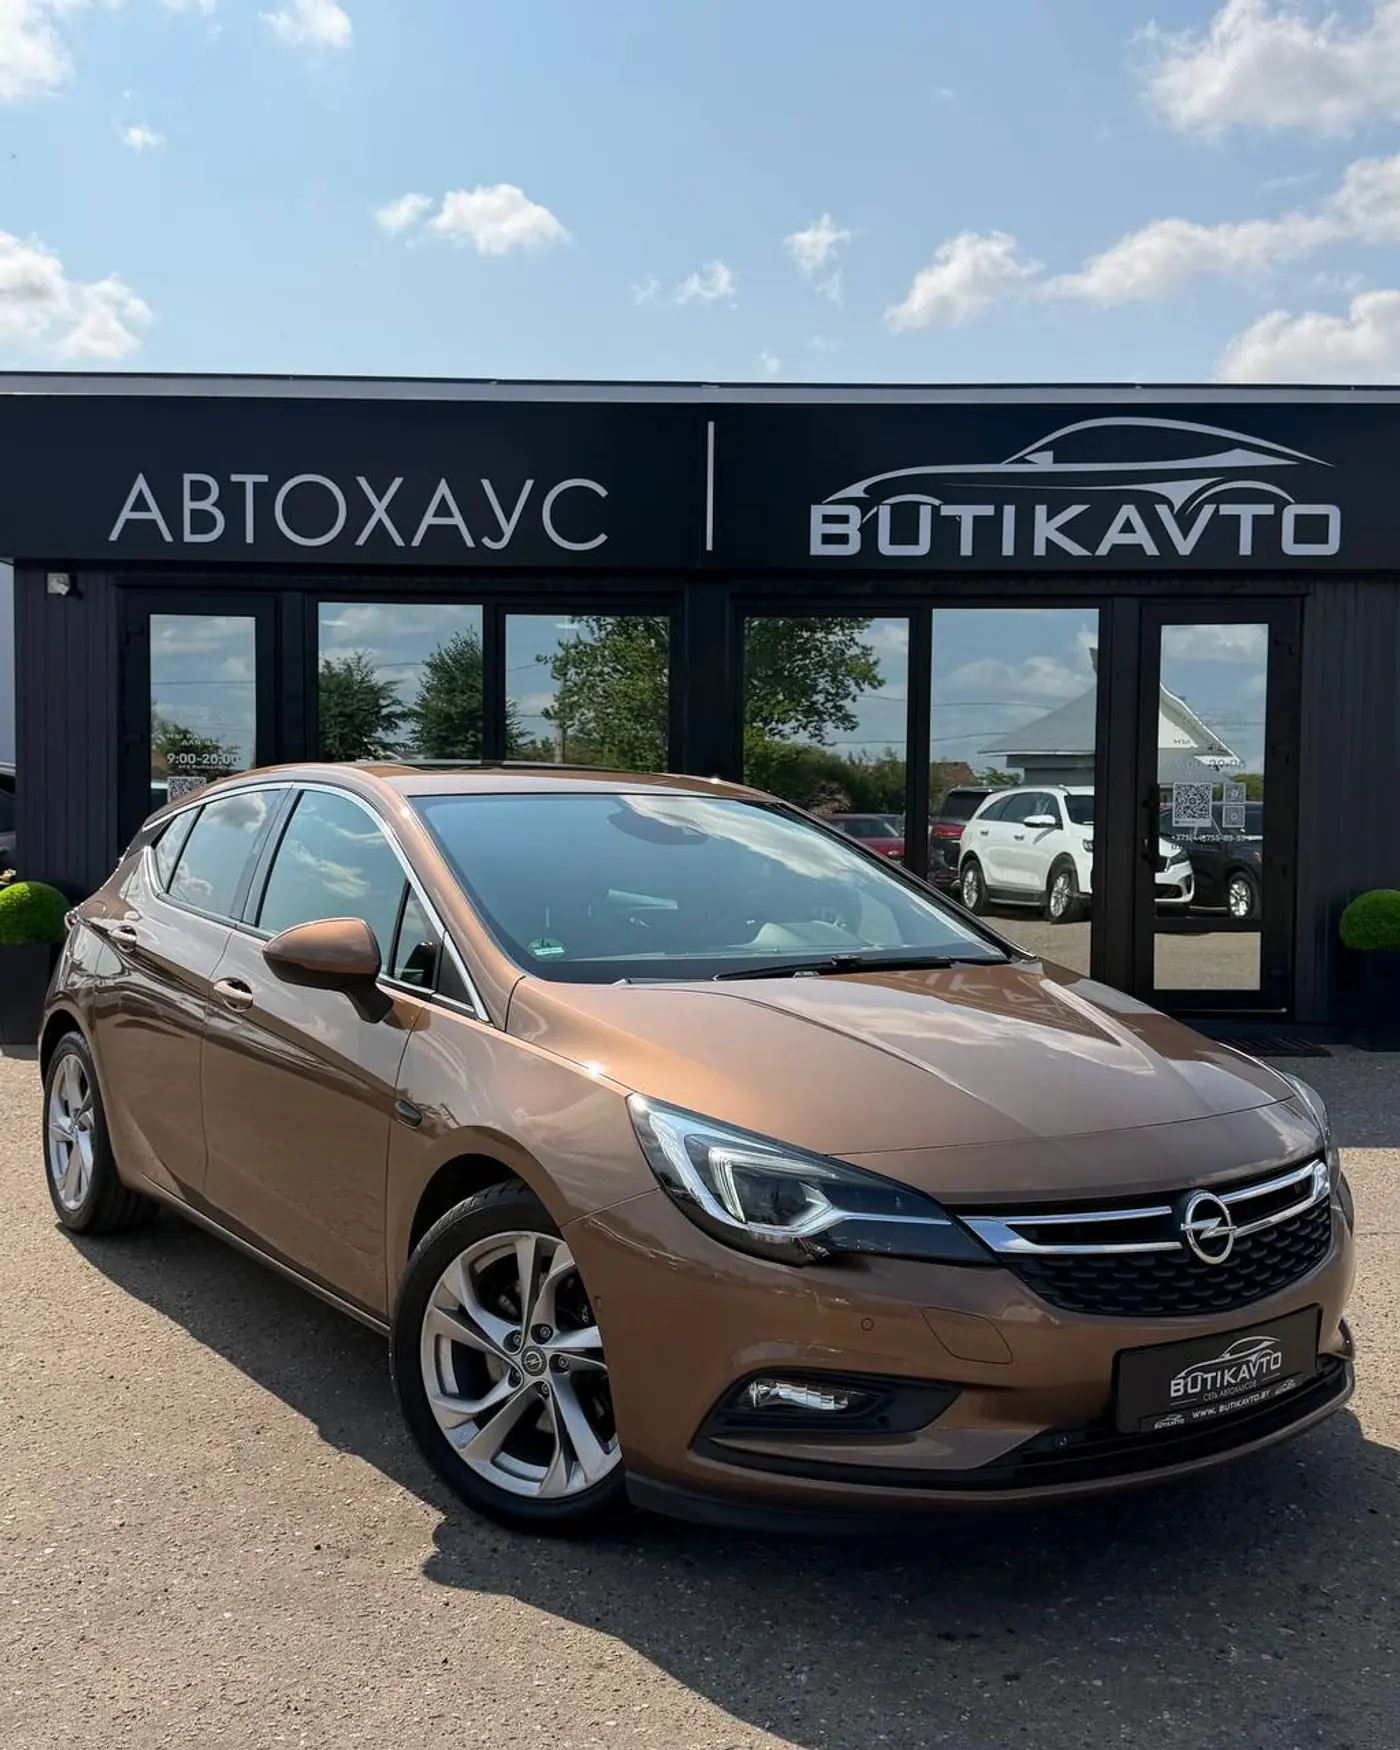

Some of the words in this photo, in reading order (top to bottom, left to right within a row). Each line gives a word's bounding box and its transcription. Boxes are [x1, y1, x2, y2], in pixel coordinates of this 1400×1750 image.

[109, 472, 609, 552] АВТОХАУС
[810, 503, 1342, 557] BUTIKAVTO
[1170, 1351, 1282, 1398] BUTIKAVTO
